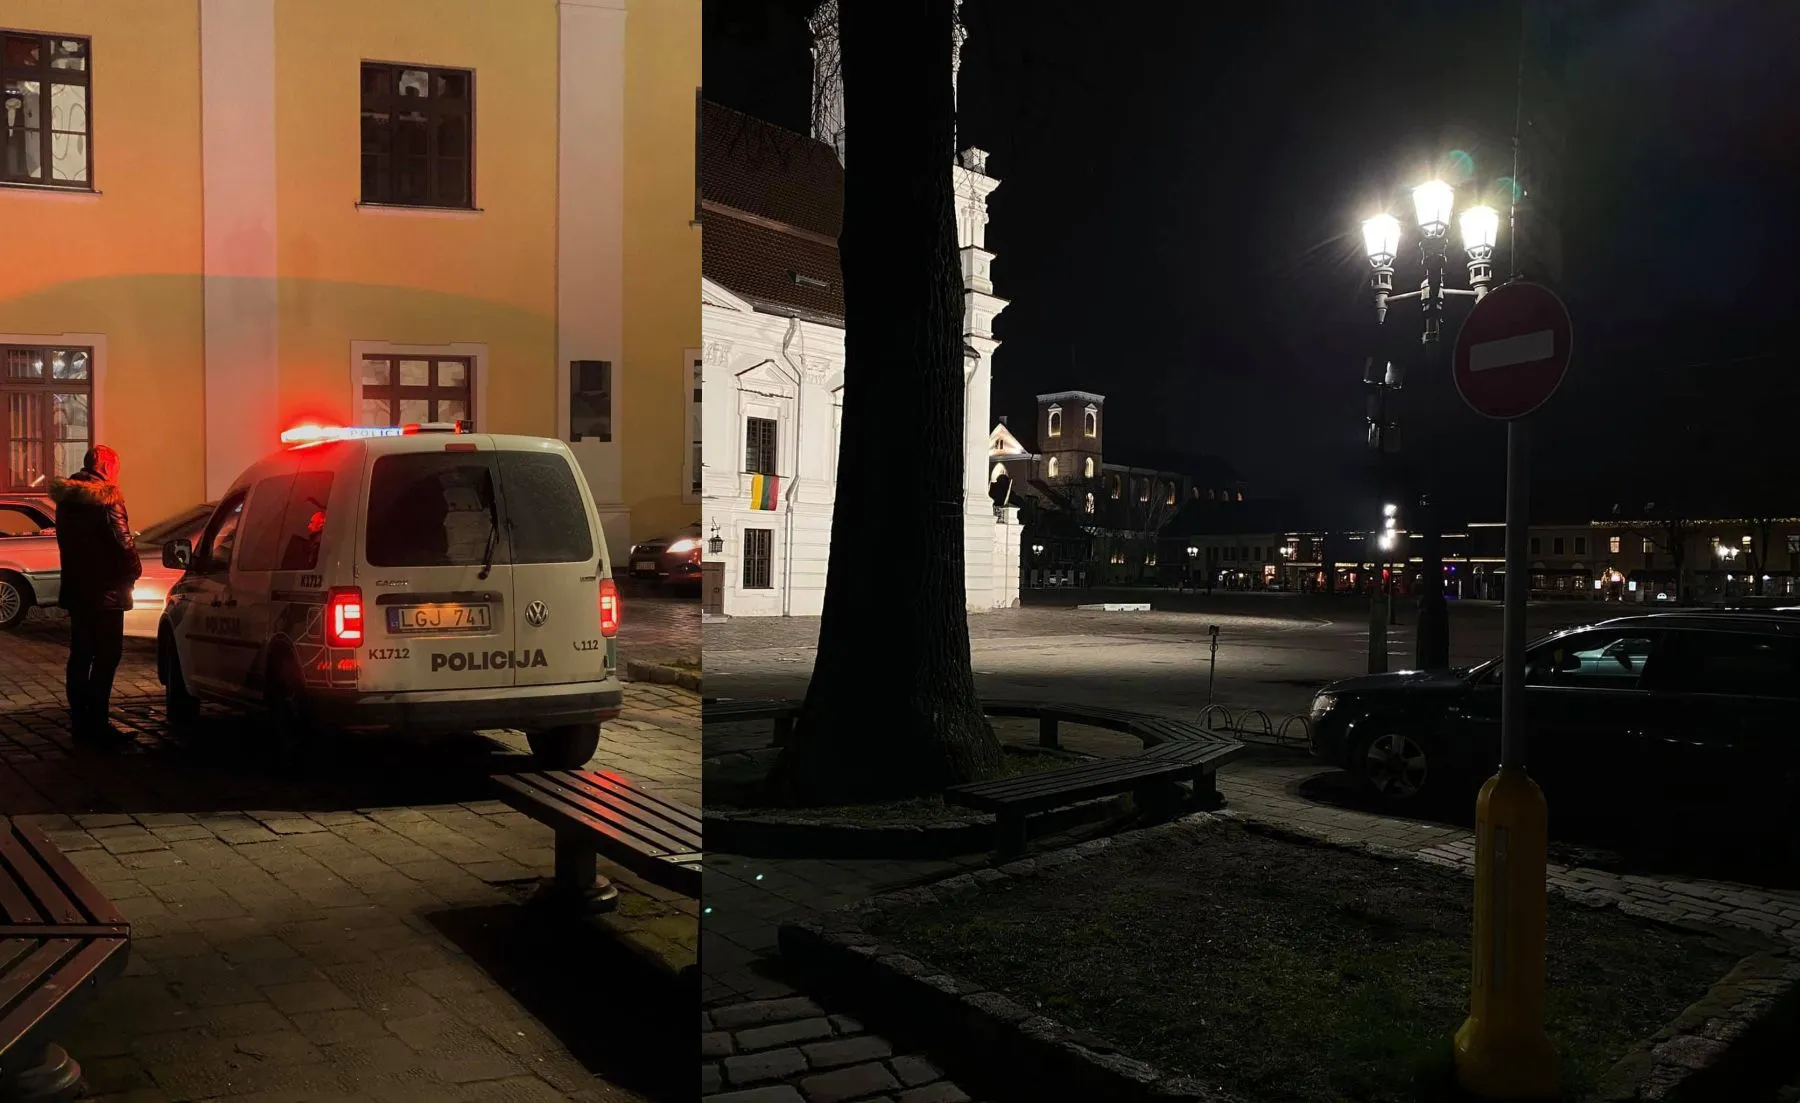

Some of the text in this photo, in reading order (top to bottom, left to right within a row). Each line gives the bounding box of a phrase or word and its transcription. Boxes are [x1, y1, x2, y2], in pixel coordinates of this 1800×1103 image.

[401, 609, 486, 627] LGJ 741
[580, 639, 599, 651] 112
[368, 647, 410, 660] K1712
[431, 649, 548, 673] POLICIJA
